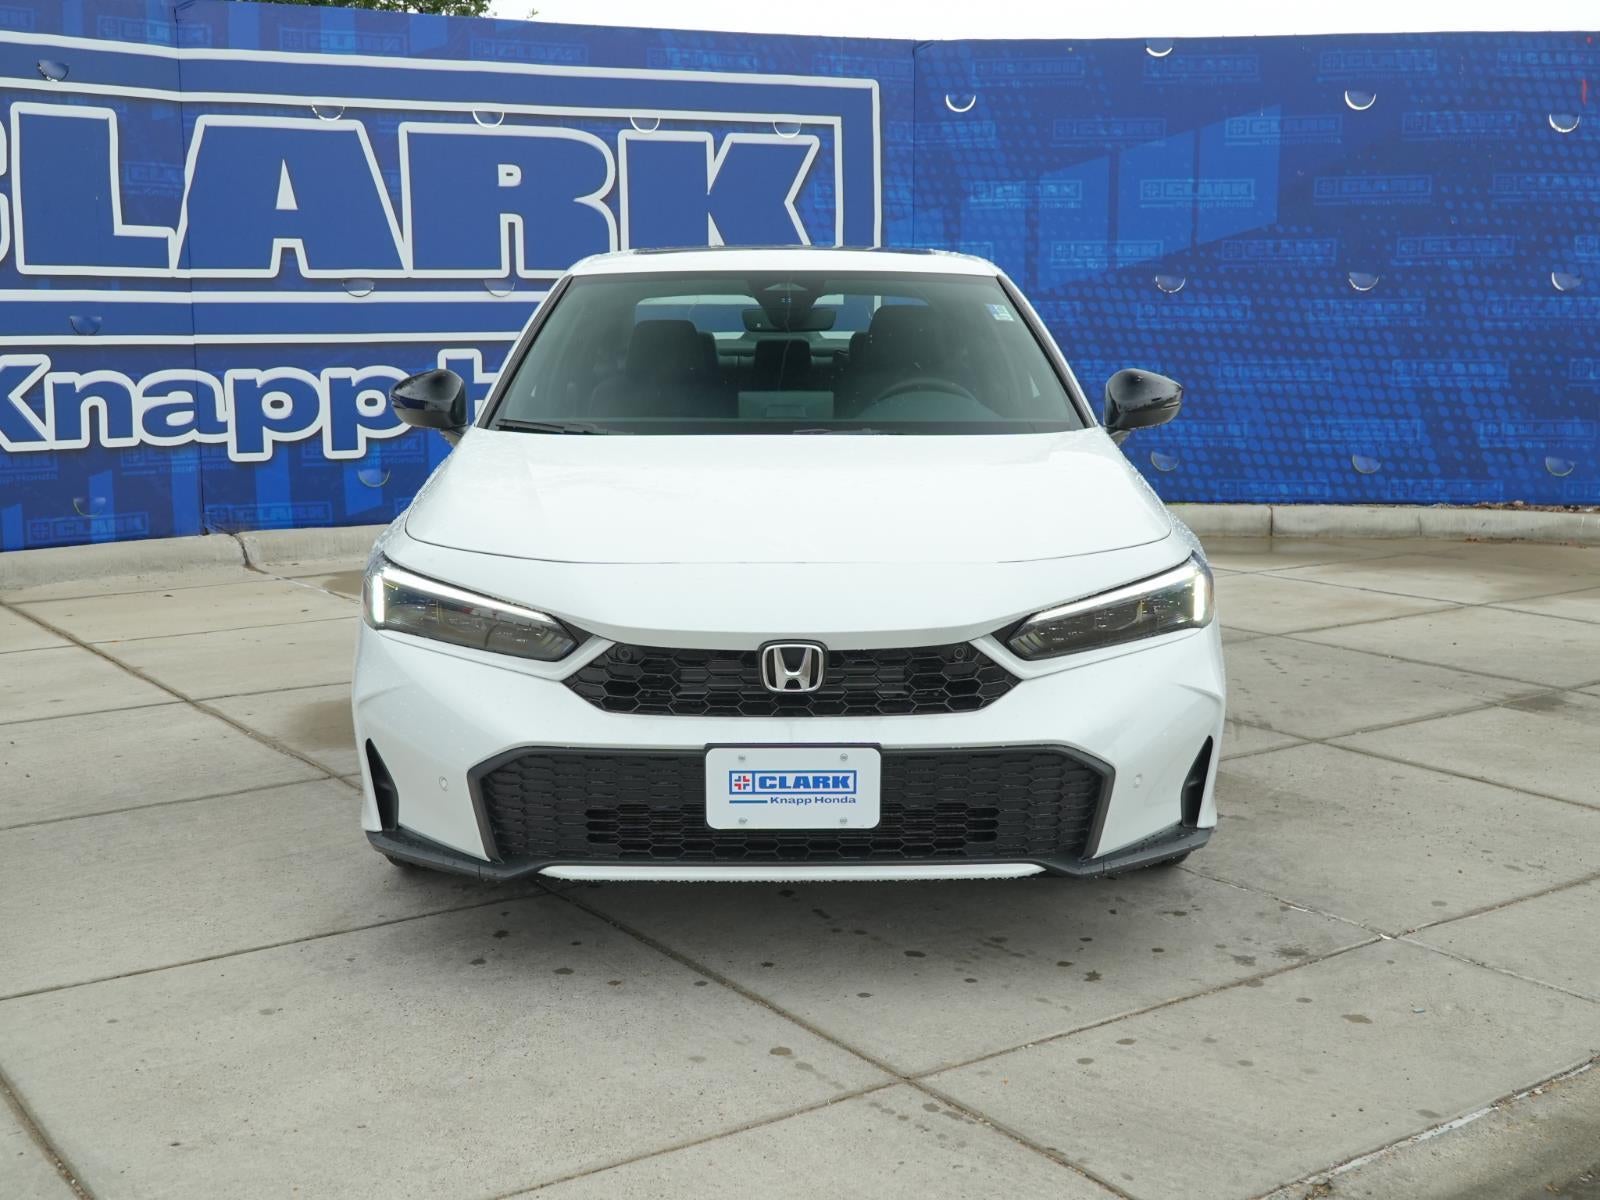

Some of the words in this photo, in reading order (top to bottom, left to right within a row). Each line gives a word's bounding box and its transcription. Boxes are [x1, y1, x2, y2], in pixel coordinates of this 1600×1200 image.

[0, 101, 822, 279] LARK
[759, 775, 850, 789] CLARK
[770, 796, 812, 806] Knapp
[814, 796, 856, 804] Honda
